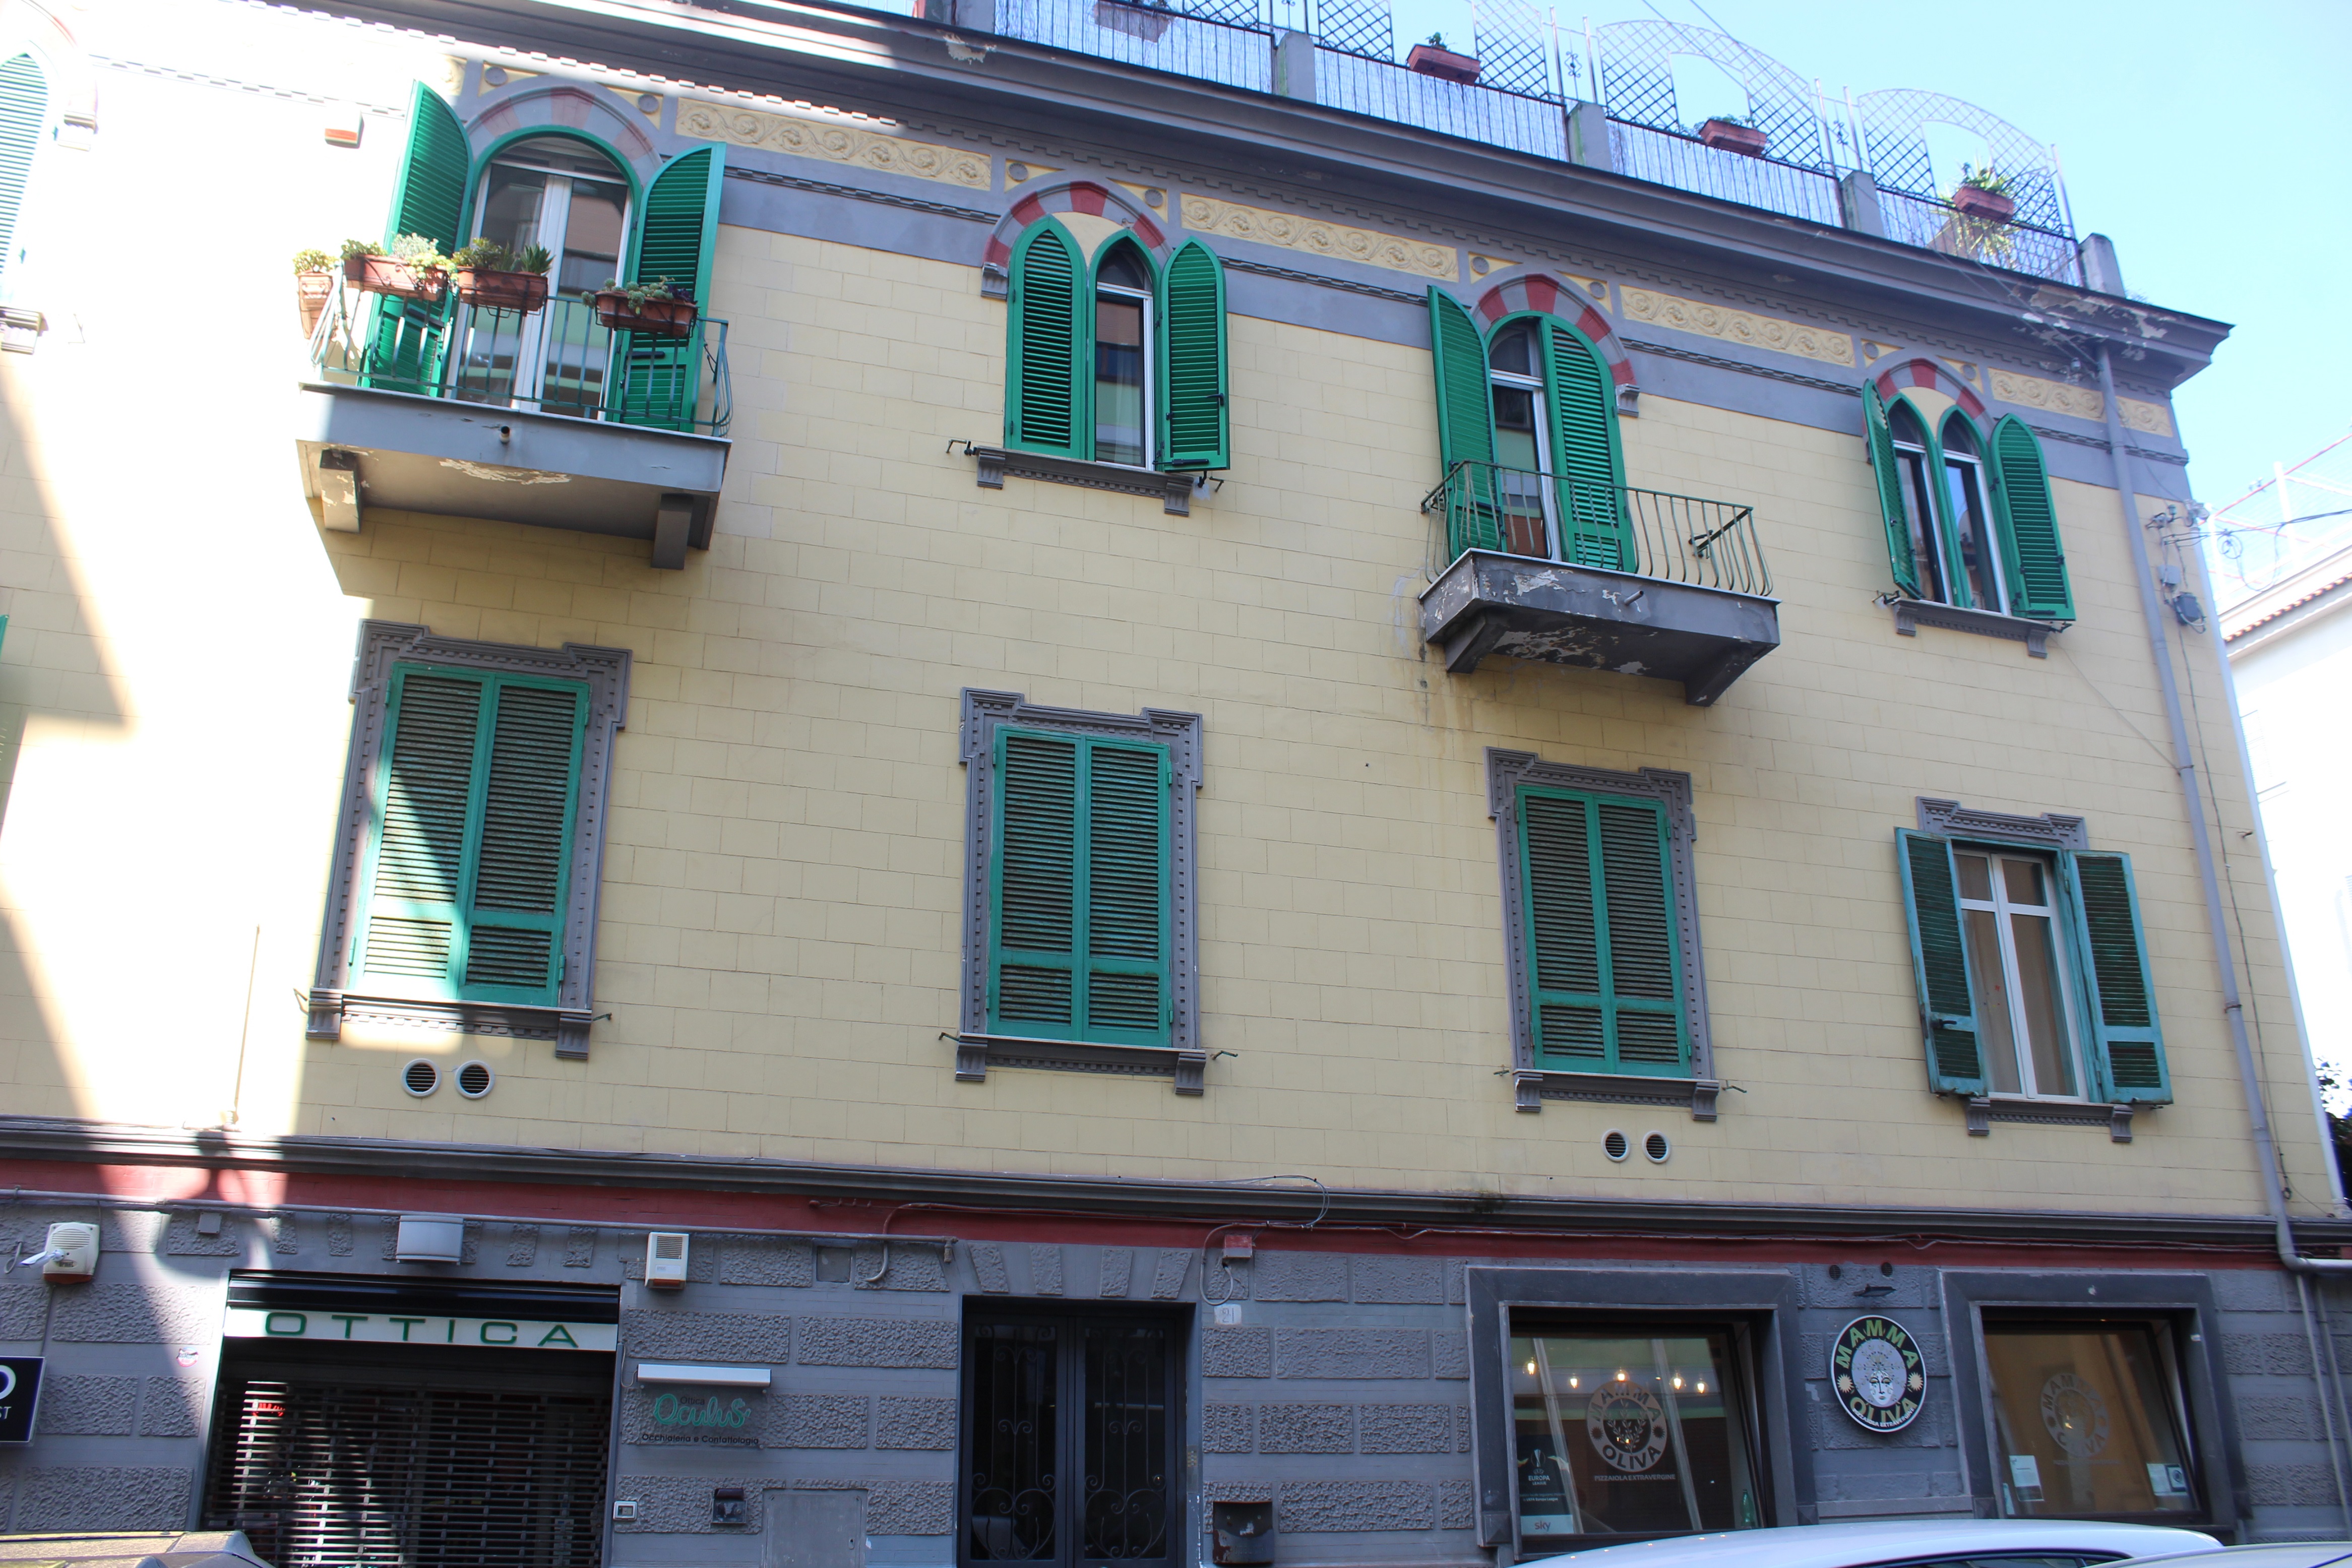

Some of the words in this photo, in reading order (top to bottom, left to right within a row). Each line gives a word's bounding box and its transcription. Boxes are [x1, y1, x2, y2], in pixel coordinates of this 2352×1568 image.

[265, 1312, 578, 1348] OTTICA
[1836, 1320, 1919, 1369] MAMMA
[680, 1397, 705, 1405] Ottica
[1590, 1383, 1661, 1422] MAMMA
[642, 1433, 691, 1442] Occhialeria
[702, 1435, 759, 1446] Contattologia
[1602, 1445, 1661, 1469] OLIVA
[1535, 1520, 1551, 1531] sky
